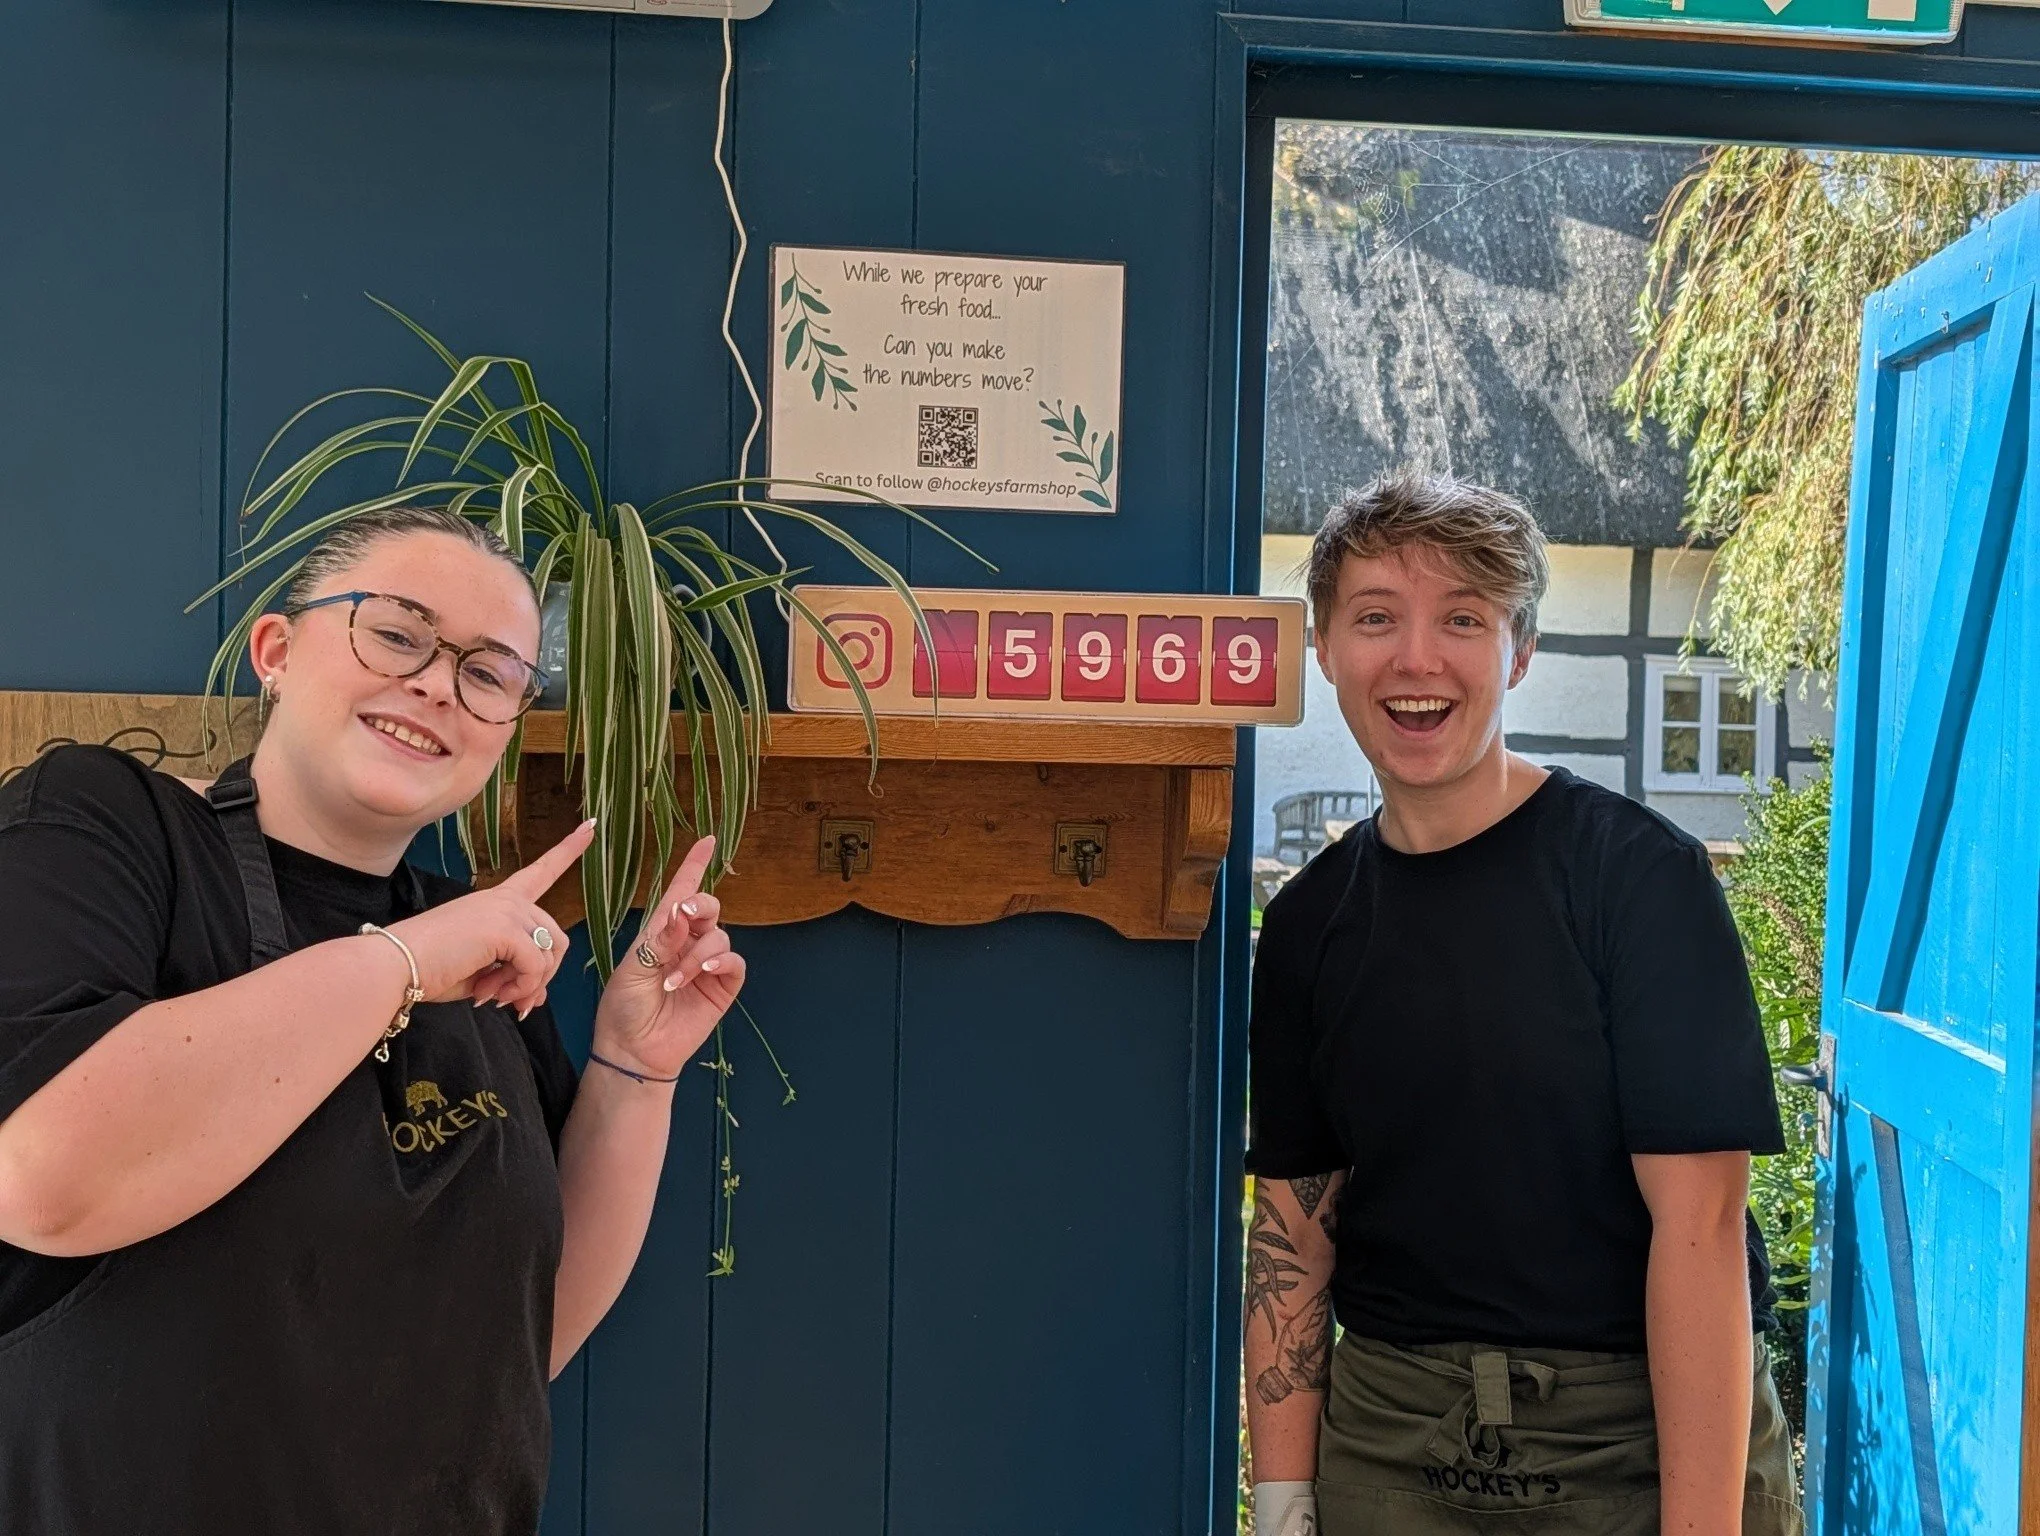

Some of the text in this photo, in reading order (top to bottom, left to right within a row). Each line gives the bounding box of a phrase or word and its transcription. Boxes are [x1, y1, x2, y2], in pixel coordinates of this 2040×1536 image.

[843, 261, 1048, 297] While we prepare your
[901, 294, 1001, 320] fresh food...
[884, 334, 1006, 364] Can you make
[863, 363, 1035, 392] the numbers move?
[815, 472, 1077, 498] Scan to follow @hockeysfarmshop
[1003, 629, 1262, 685] 5969
[382, 1090, 508, 1153] OCKEY'S
[1420, 1465, 1561, 1497] HOCKEY'S
